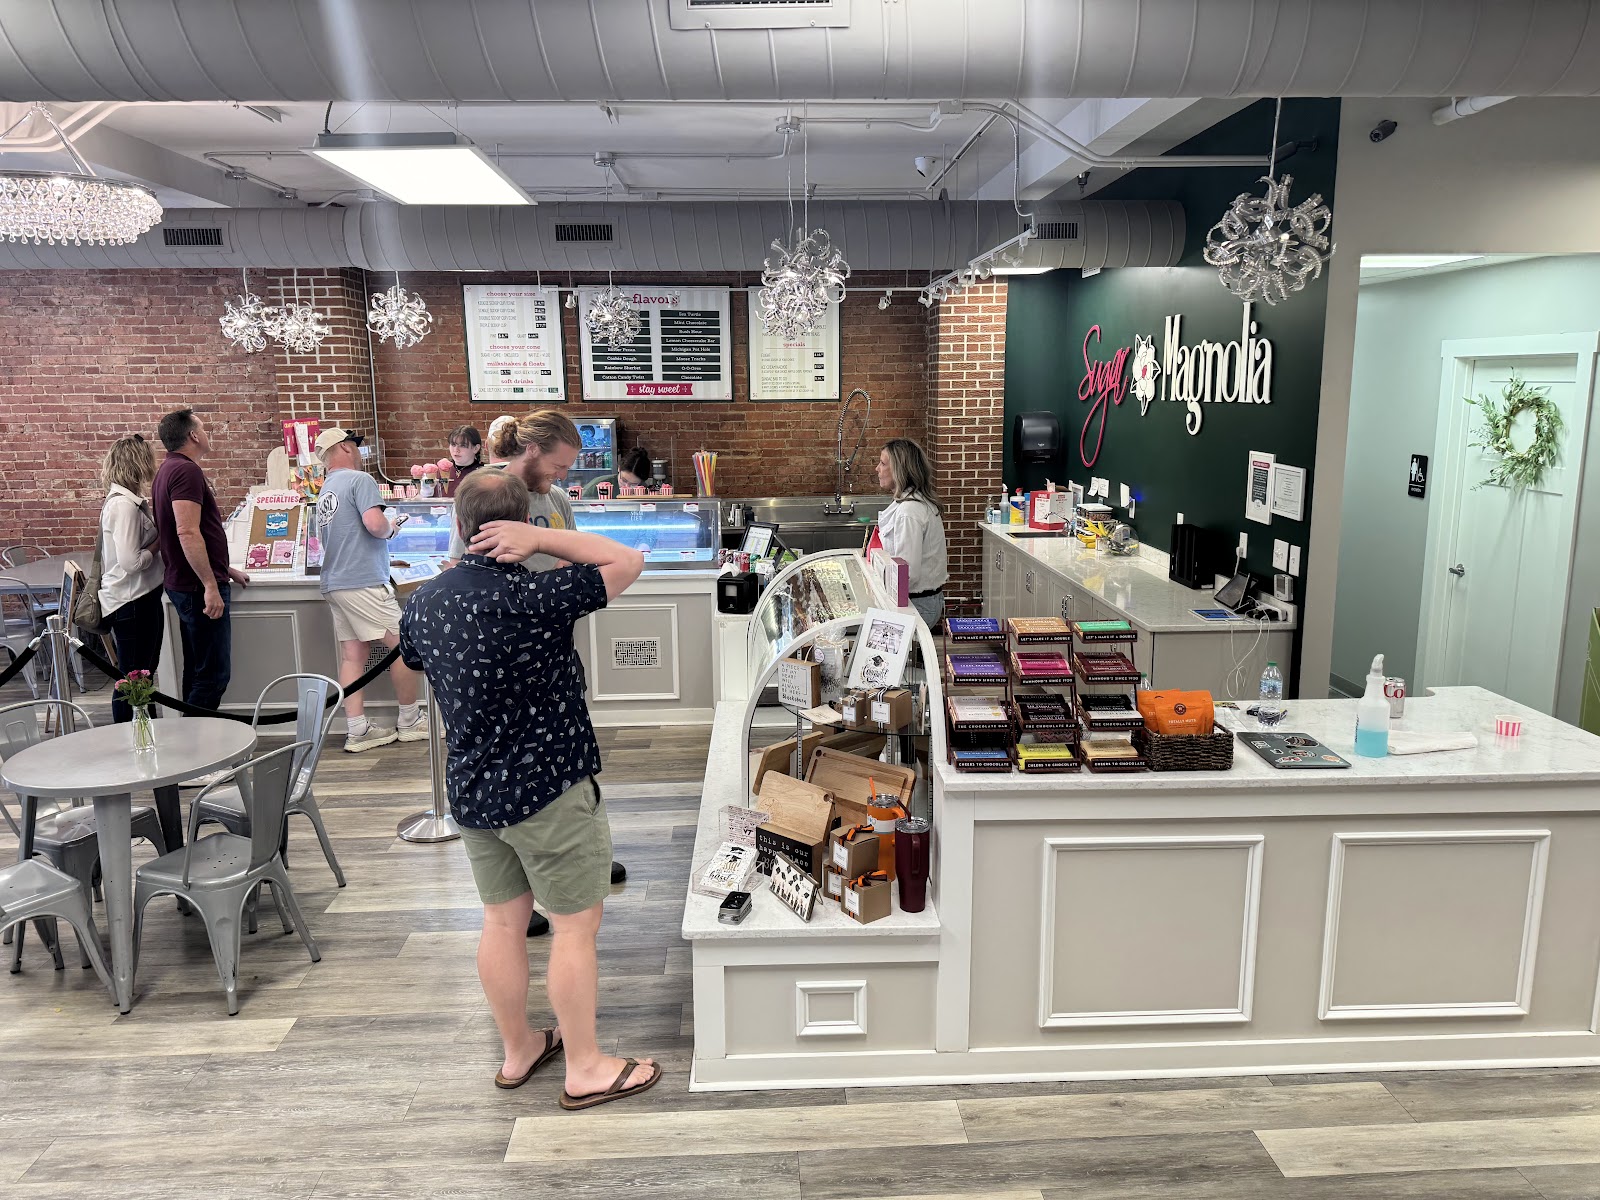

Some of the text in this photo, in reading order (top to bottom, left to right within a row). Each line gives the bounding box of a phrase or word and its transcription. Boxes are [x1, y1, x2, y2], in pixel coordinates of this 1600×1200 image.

[638, 383, 680, 395] stay sweet
[1078, 302, 1273, 467] Sugar Magnolia
[1384, 684, 1406, 698] Co
[782, 694, 806, 705] Blacksburg
[759, 835, 809, 857] this is our
[759, 844, 782, 856] happ
